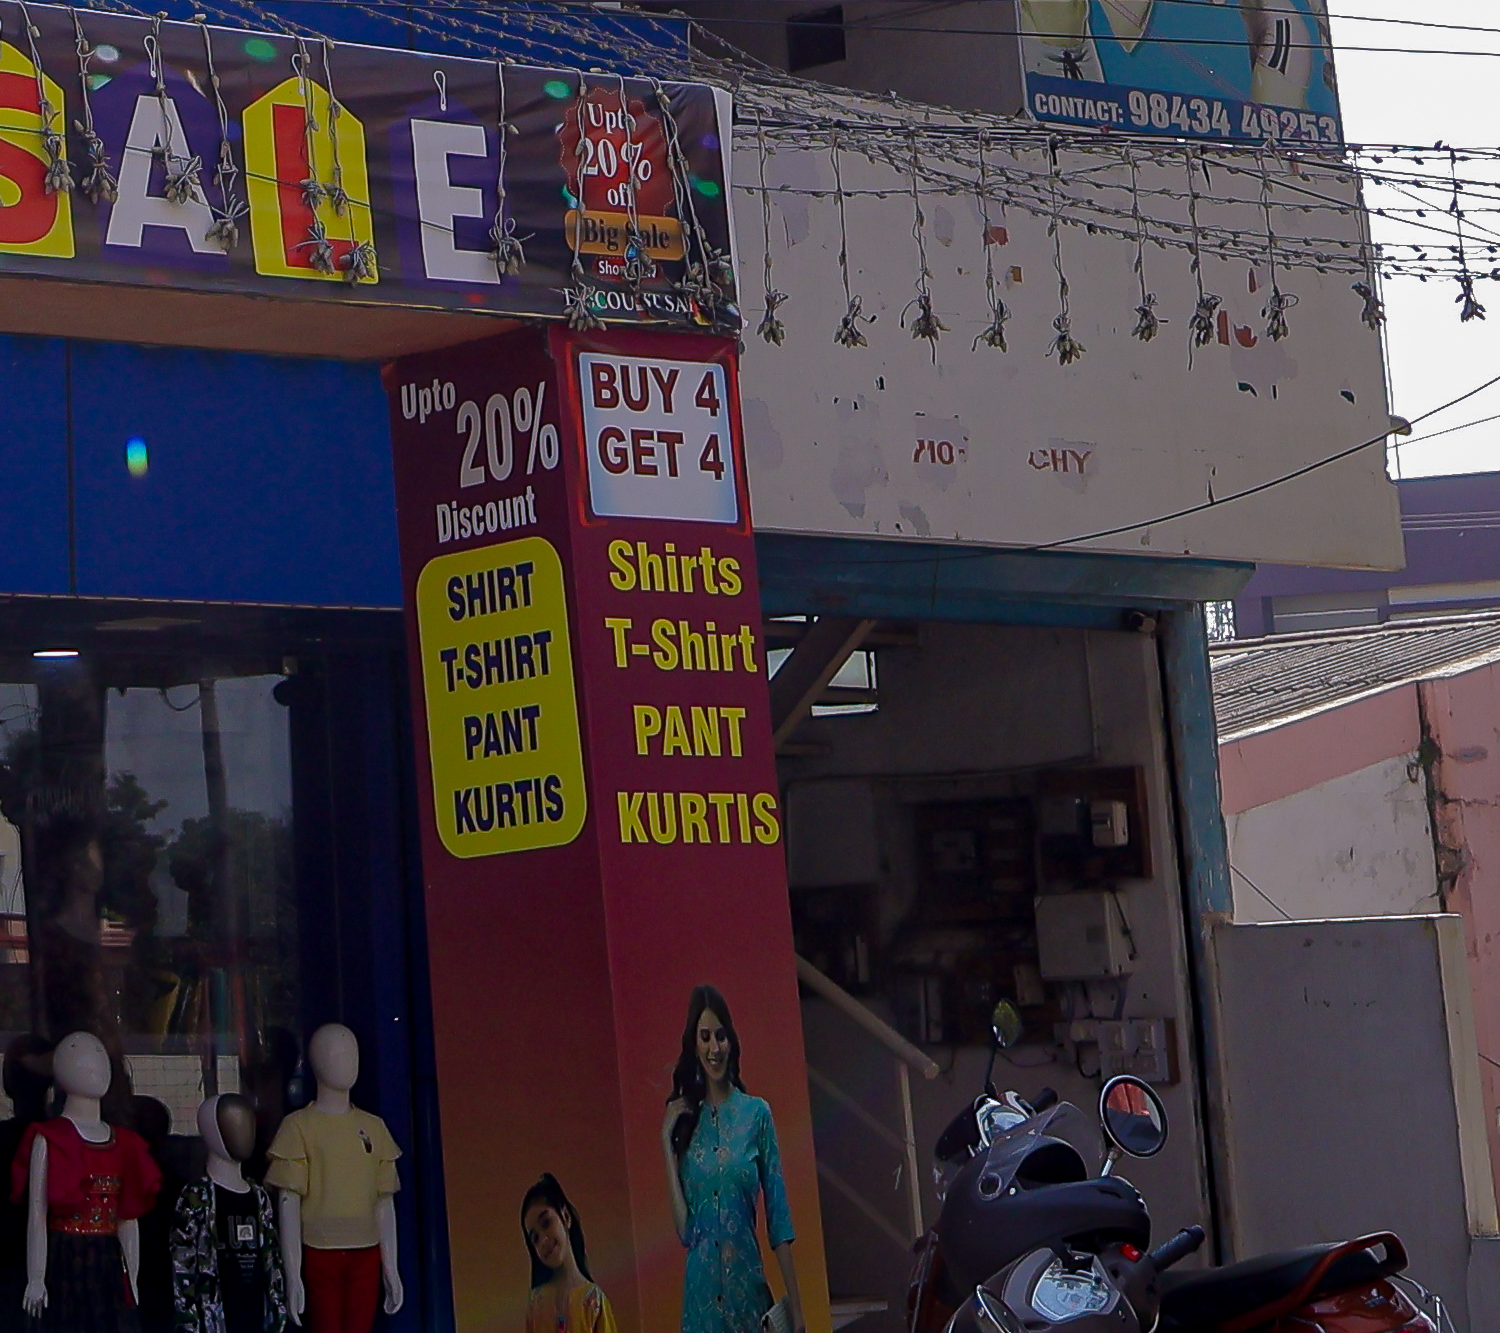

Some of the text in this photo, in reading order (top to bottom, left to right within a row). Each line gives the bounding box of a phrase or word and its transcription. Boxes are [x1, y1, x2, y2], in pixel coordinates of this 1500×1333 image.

[1033, 90, 1124, 125] CONTACT:
[1127, 86, 1231, 138] 98434
[400, 378, 456, 424] Upto
[590, 361, 720, 419] BUY 4
[455, 381, 560, 489] 20%
[598, 426, 726, 482] GET 4
[435, 484, 537, 543] Discount
[446, 561, 535, 622] SHIRT
[608, 538, 743, 597] Shirts
[440, 629, 553, 693] T-SHIRT
[604, 616, 758, 674] T-Shirt
[462, 703, 541, 762] PANT
[632, 703, 747, 758] PANT
[453, 773, 566, 837] KURTIS
[617, 791, 781, 846] KURTIS
